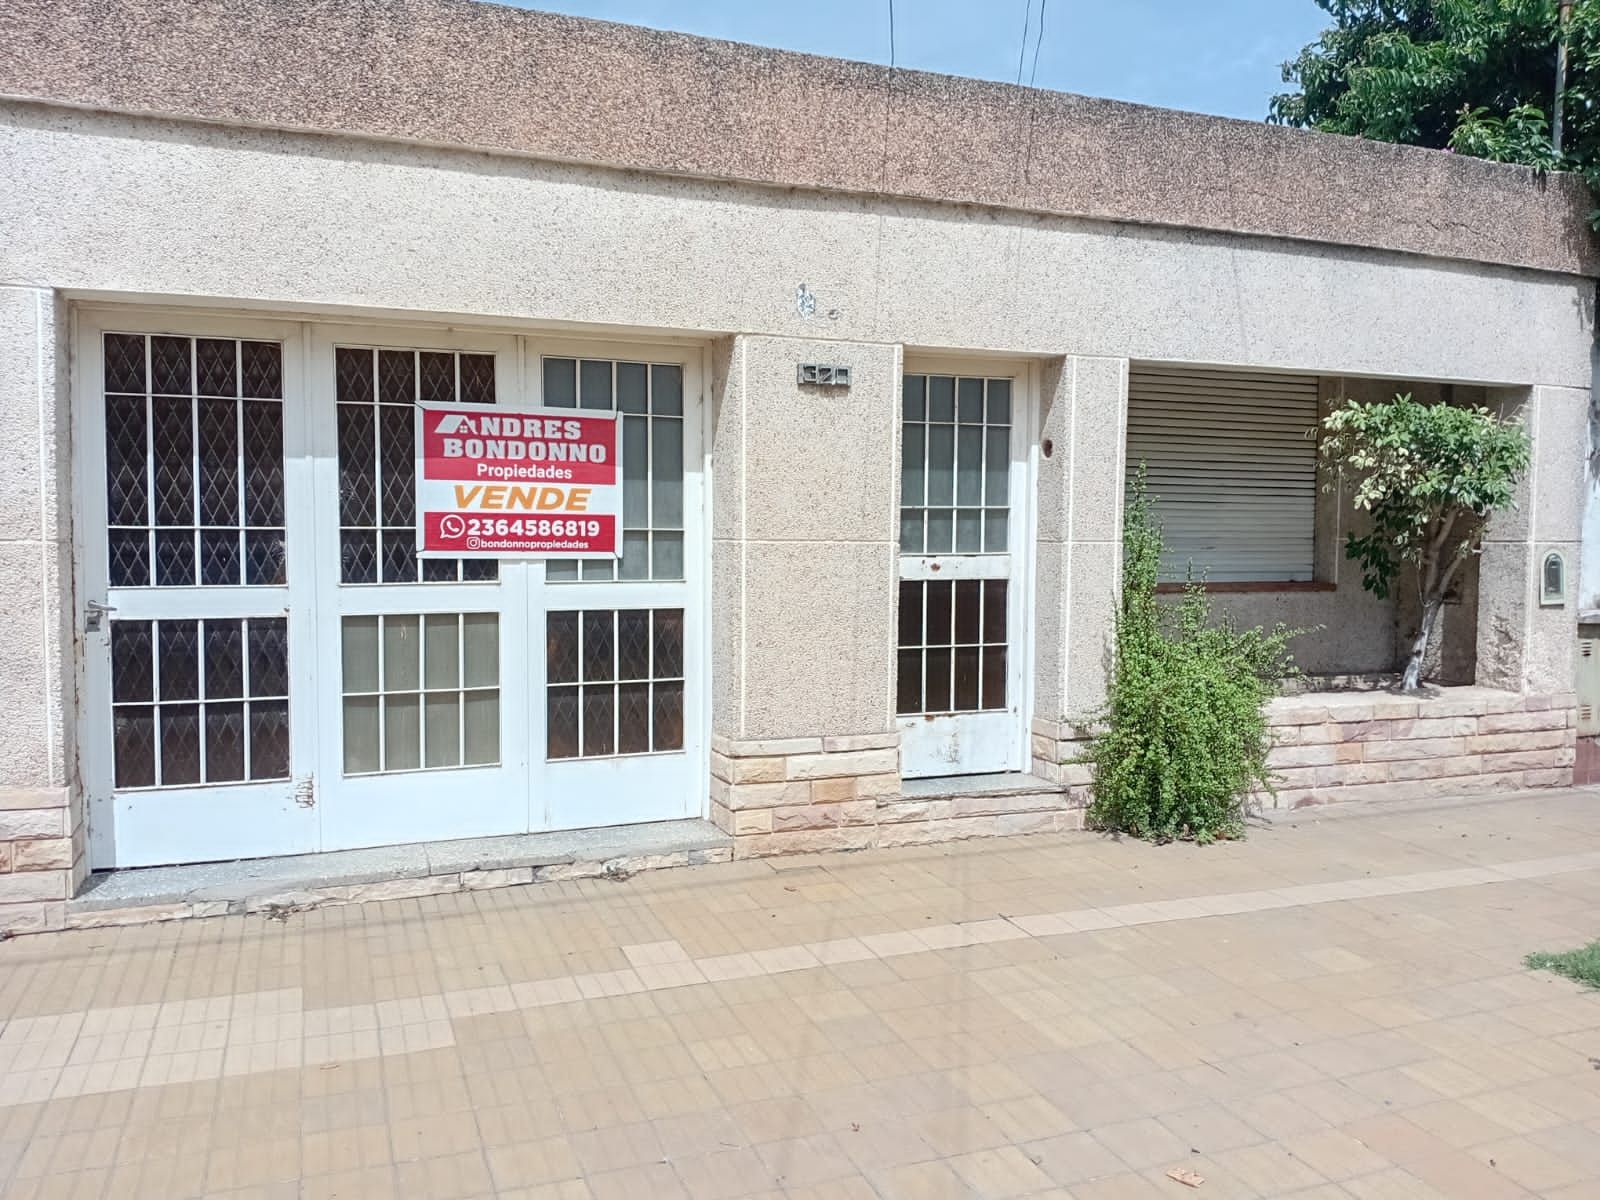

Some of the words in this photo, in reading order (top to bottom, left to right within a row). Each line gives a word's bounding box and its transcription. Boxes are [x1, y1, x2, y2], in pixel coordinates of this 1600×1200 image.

[434, 414, 582, 440] ANDRES
[444, 438, 607, 463] BONDONNO
[477, 463, 573, 480] Propiedades
[454, 485, 592, 511] VENDE
[467, 519, 600, 537] 2364586819
[481, 539, 589, 550] bondonnopropiedades
